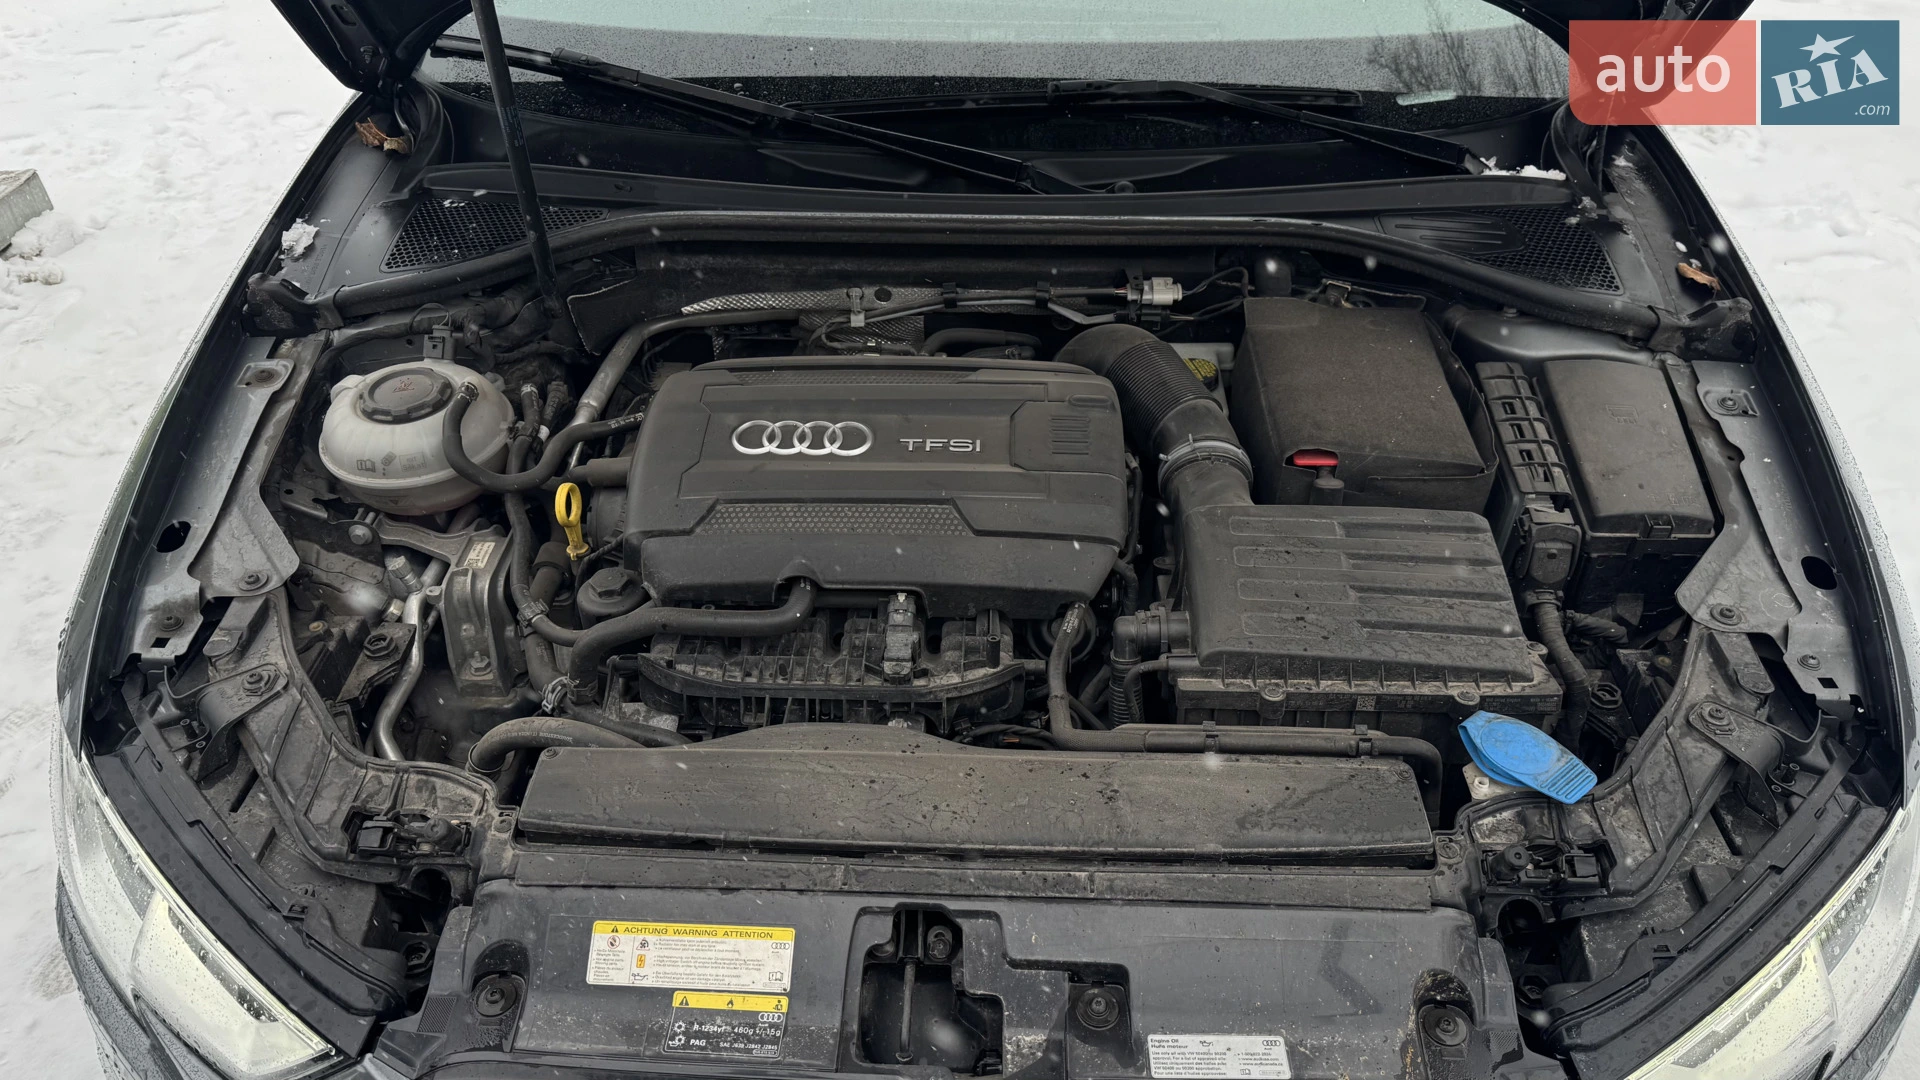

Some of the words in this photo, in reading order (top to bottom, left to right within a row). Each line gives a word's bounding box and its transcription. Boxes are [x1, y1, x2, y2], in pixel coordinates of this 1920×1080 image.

[899, 438, 982, 453] TFSI
[623, 927, 668, 935] ACHTUNG
[673, 928, 718, 937] WARNING
[722, 930, 774, 939] ATTENTION
[689, 1038, 707, 1047] PAG
